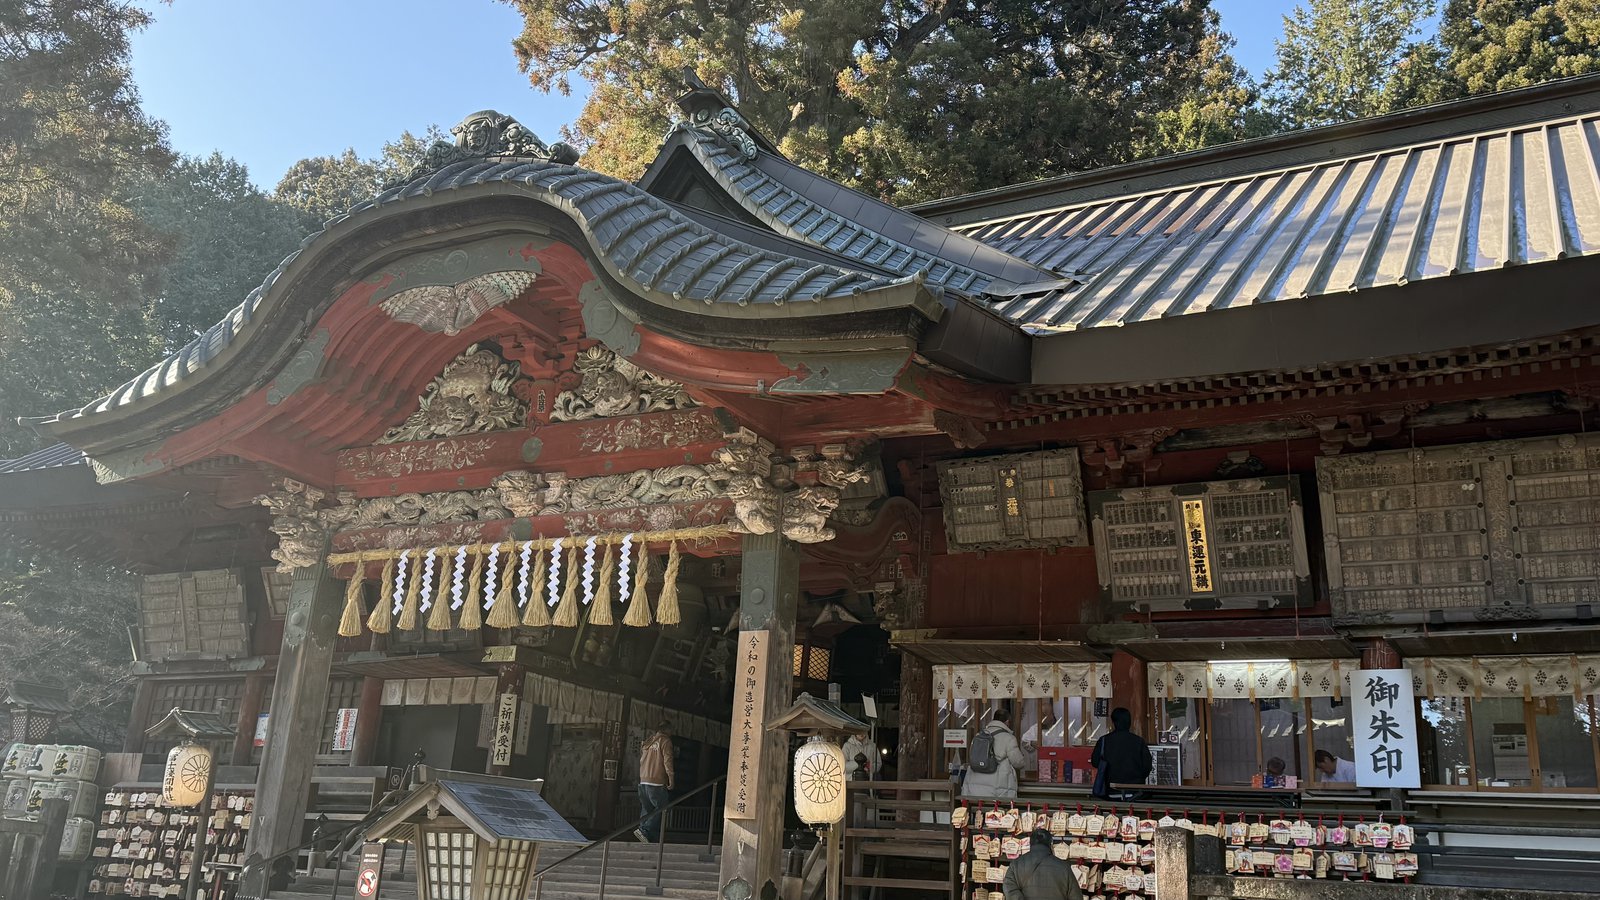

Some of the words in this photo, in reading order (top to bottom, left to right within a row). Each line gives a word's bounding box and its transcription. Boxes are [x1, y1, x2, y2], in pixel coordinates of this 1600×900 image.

[1190, 528, 1209, 589] 東運元講
[495, 696, 514, 763] ご祈祷受付
[1364, 675, 1403, 780] 御朱印
